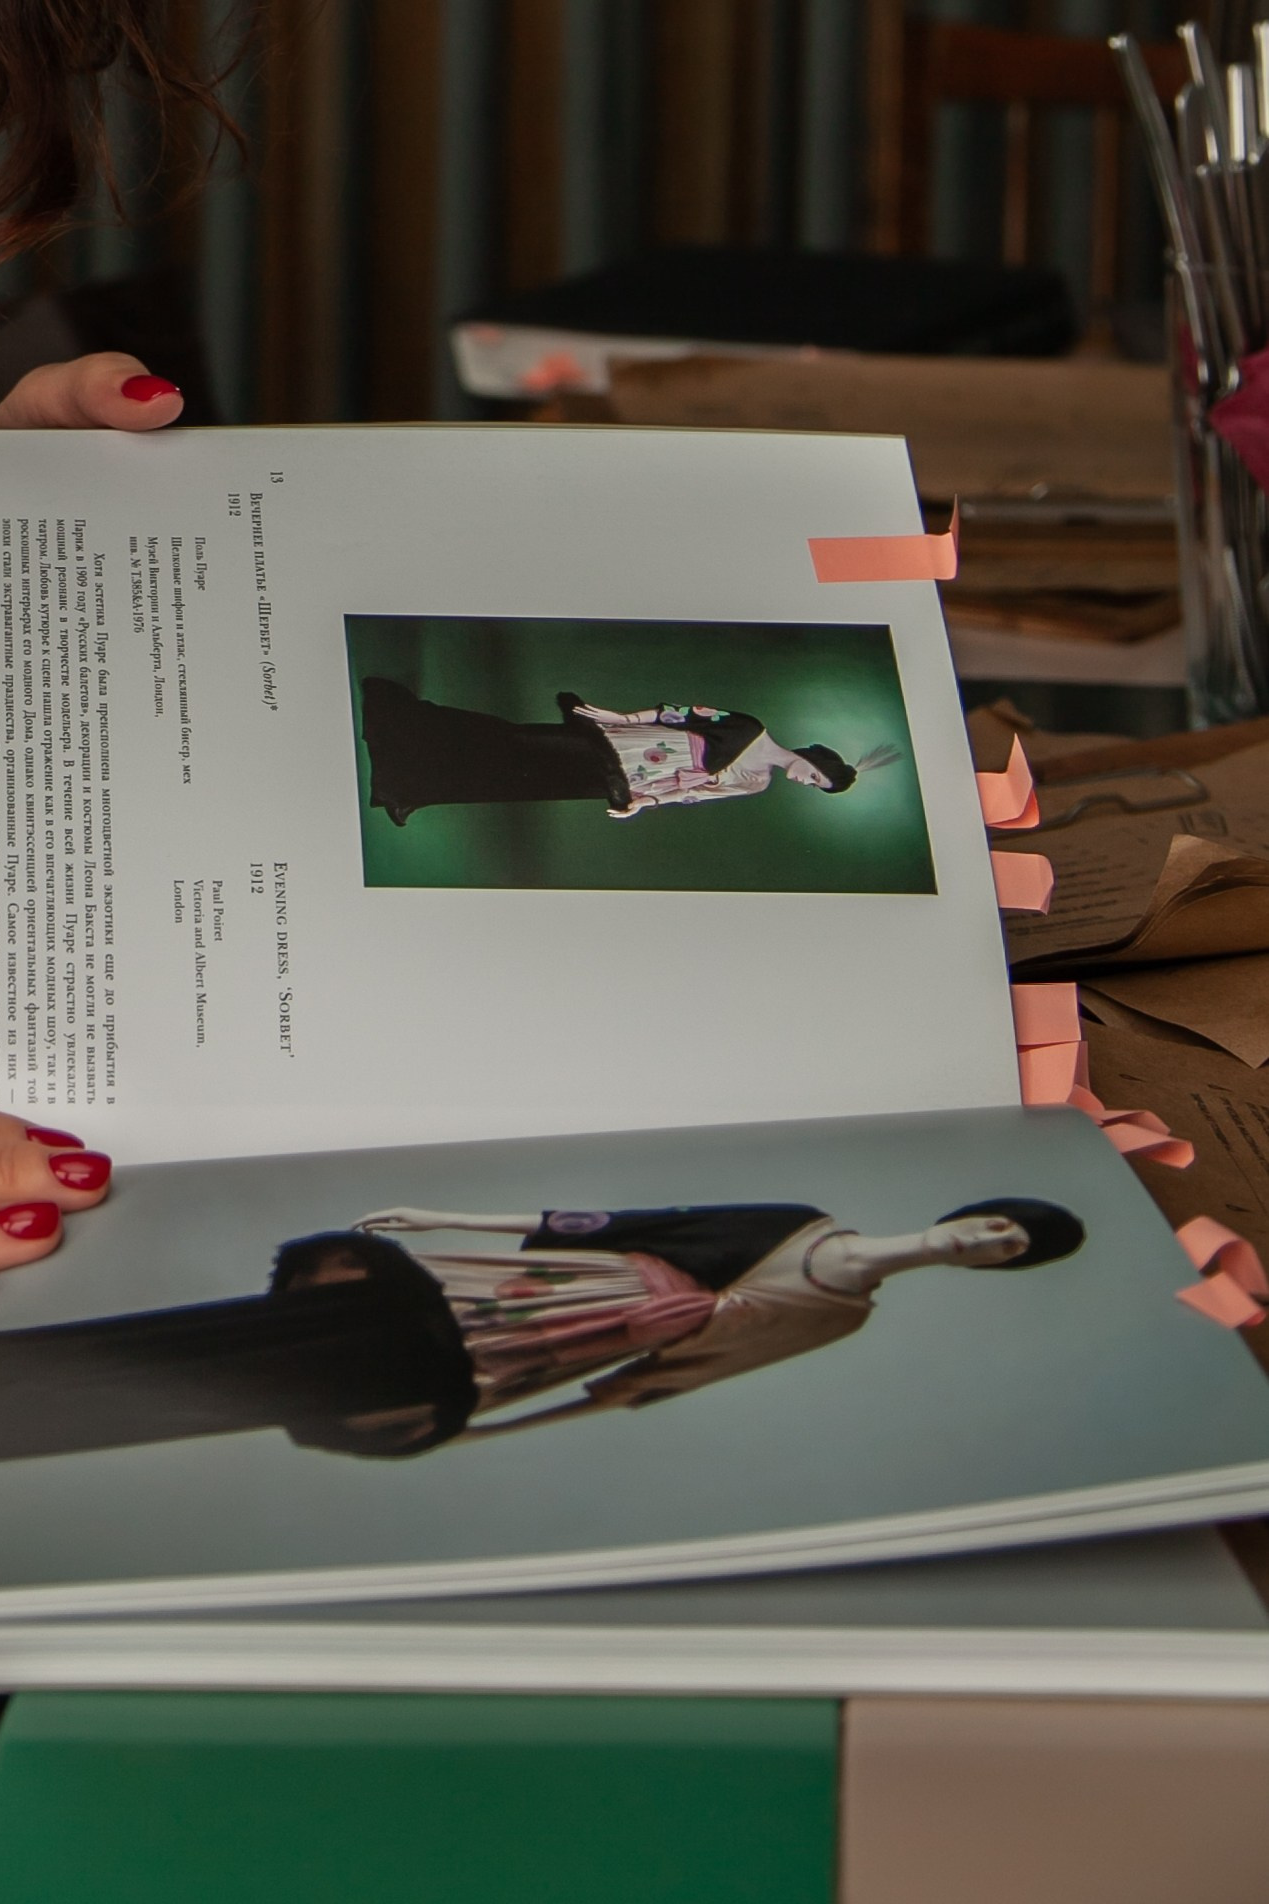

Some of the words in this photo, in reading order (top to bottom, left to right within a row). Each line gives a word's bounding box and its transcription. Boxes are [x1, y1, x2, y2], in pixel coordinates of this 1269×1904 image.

[271, 471, 284, 483] 13
[228, 493, 242, 516] 1912
[3, 518, 11, 546] эпохи
[17, 519, 30, 574] роскошных
[36, 519, 48, 560] театром.
[57, 519, 68, 561] мощный
[72, 519, 86, 552] Париж
[145, 537, 159, 564] Музей
[195, 537, 206, 561] Поль
[4, 551, 12, 578] стали
[40, 562, 52, 600] Любовь
[77, 566, 88, 587] 1909
[94, 553, 106, 577] Хотя
[172, 537, 182, 585] Шелковые
[195, 563, 208, 591] Пуаре
[19, 578, 31, 635] интерьерах
[55, 567, 68, 611] резонанс
[75, 591, 86, 613] году
[96, 582, 105, 626] эстетика
[147, 567, 160, 613] Виктории
[172, 587, 186, 621] шифон
[1, 583, 14, 669] экстравагантные
[38, 603, 50, 646] кутюрье
[57, 629, 70, 686] творчестве
[95, 632, 109, 664] Пуаре
[150, 624, 164, 672] Альберта,
[177, 632, 185, 661] атлас,
[24, 660, 33, 706] модного
[42, 658, 51, 688] сцене
[99, 669, 110, 696] была
[179, 663, 191, 724] стеклянный
[2, 674, 14, 744] празднества,
[43, 691, 52, 726] нашла
[155, 675, 165, 718] Лондон,
[23, 710, 36, 743] Дома,
[60, 693, 71, 753] модельера.
[97, 703, 110, 781] преисполнена
[179, 727, 192, 761] бисер,
[25, 747, 34, 788] однако
[41, 729, 53, 792] отражение
[79, 720, 91, 781] декорации
[183, 765, 191, 784] мех
[3, 749, 16, 847] организованные
[64, 774, 73, 821] течение
[26, 793, 37, 893] квинтэссенцией
[65, 828, 76, 855] всей
[84, 799, 93, 854] костюмы
[103, 788, 115, 876] многоцветной
[5, 854, 19, 896] Пуаре.
[66, 863, 74, 905] жизни
[85, 860, 96, 898] Леона
[213, 880, 224, 904] Paul
[251, 863, 264, 894] 1912
[46, 853, 55, 951] впечатляющих
[105, 884, 114, 945] экзотики
[174, 880, 185, 924] London
[194, 879, 205, 924] Victoria
[8, 902, 20, 945] Самое
[63, 914, 78, 954] Пуаре
[86, 904, 97, 948] Бакста
[195, 927, 206, 949] and
[214, 908, 224, 941] Poiret
[24, 899, 36, 996] ориентальных
[8, 952, 17, 1021] известное
[47, 956, 56, 1011] модных
[196, 952, 206, 988] Albert
[64, 962, 75, 1024] страстно
[87, 975, 95, 1017] могли
[25, 1002, 40, 1071] фантазий
[197, 993, 207, 1048] Museum,
[64, 1033, 76, 1104] увлекался
[103, 1014, 119, 1087] прибытия
[87, 1046, 96, 1105] вызвать
